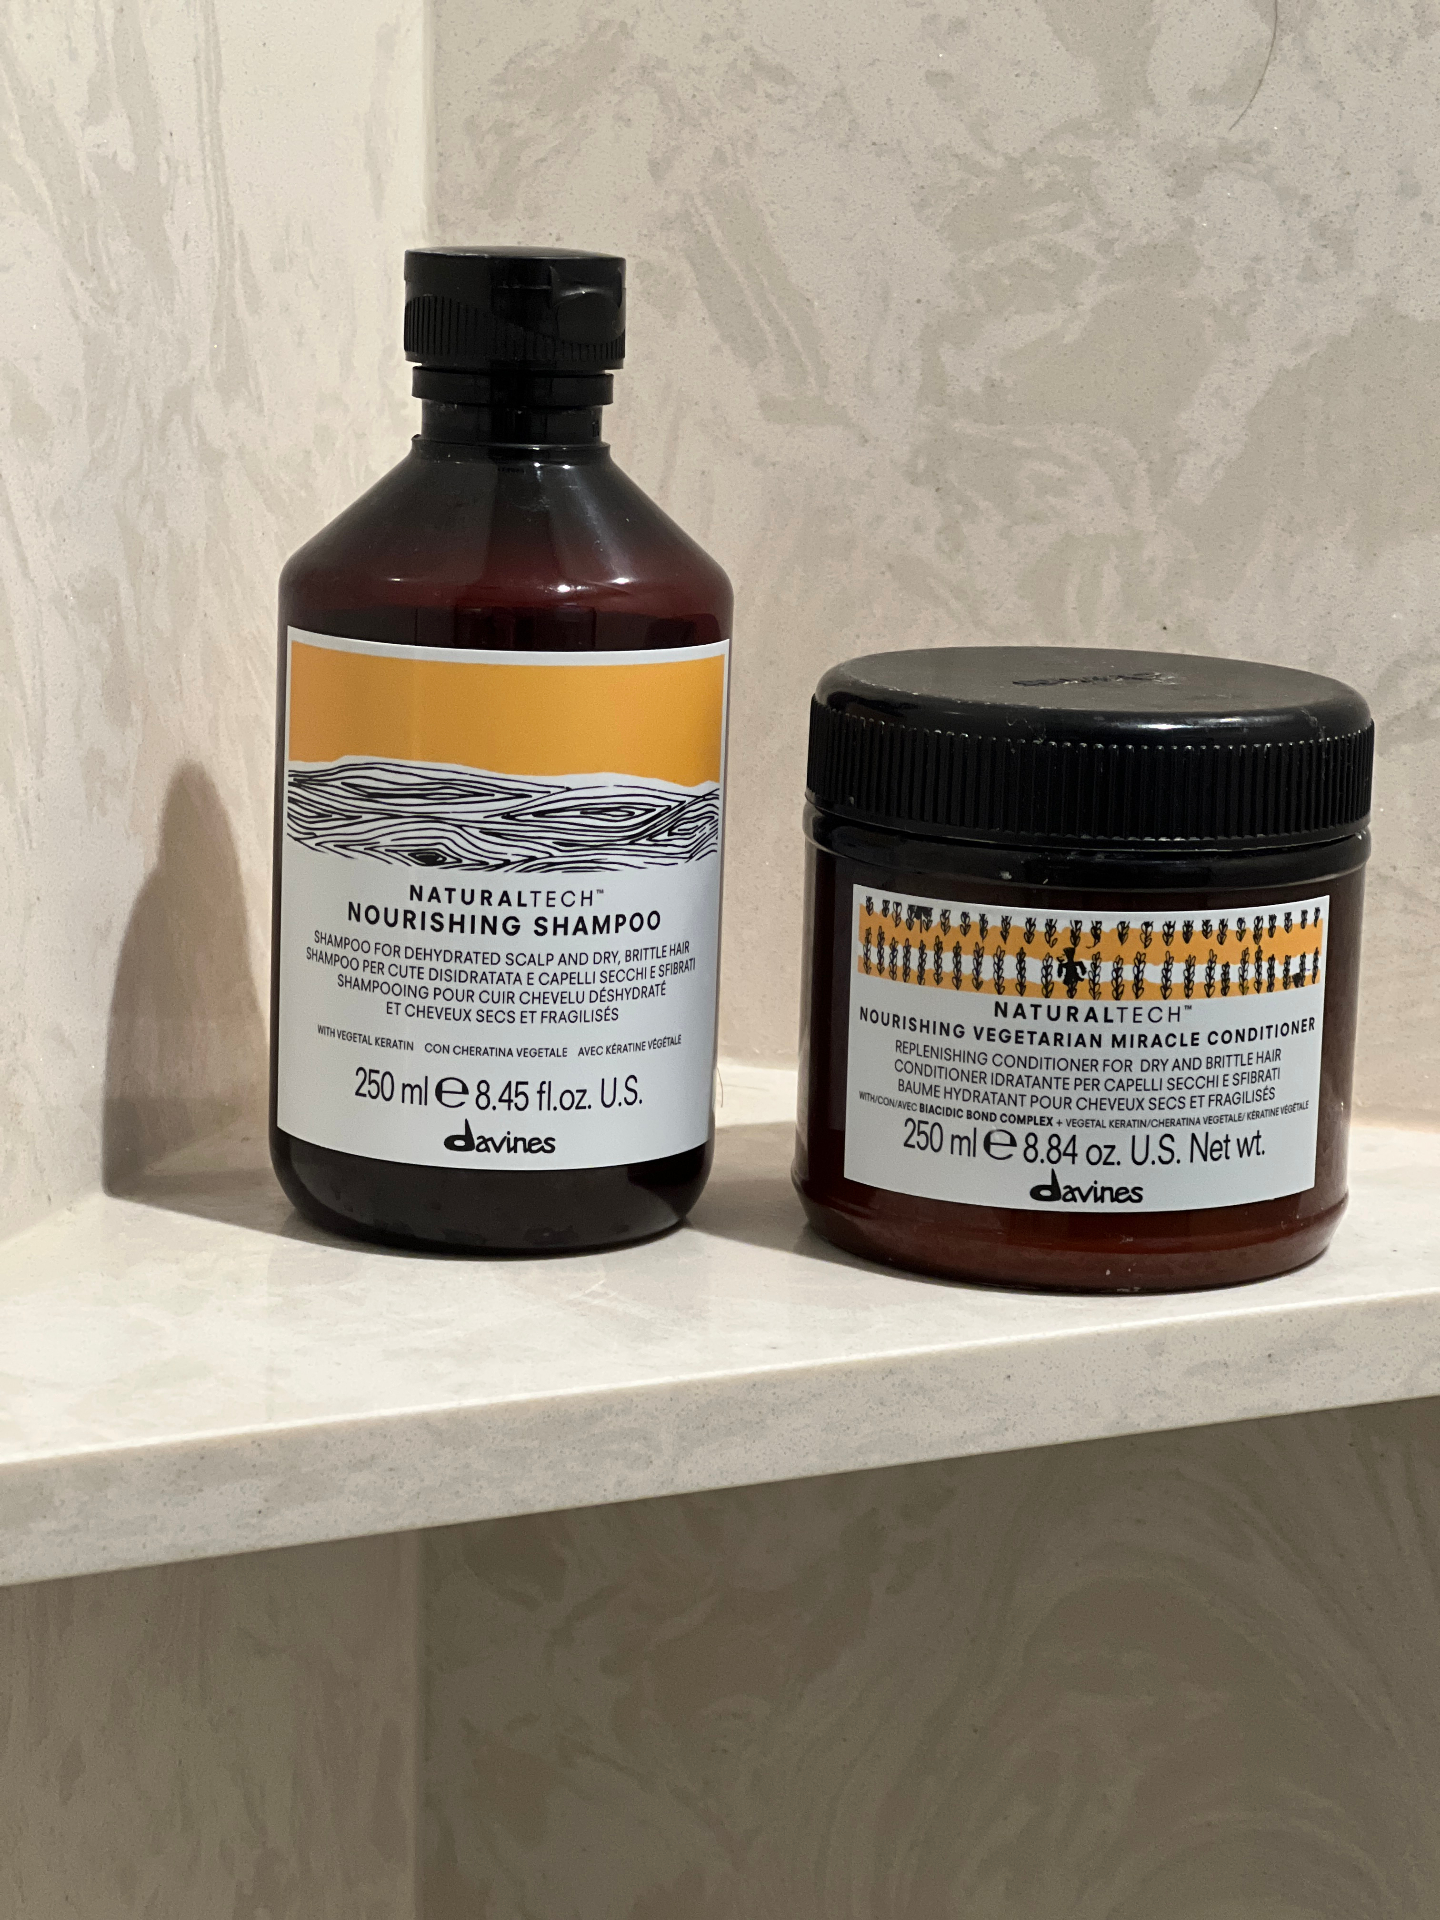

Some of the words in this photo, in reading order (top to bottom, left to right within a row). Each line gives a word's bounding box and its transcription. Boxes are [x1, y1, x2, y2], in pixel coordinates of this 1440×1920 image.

[348, 901, 521, 936] NOURISHING
[534, 910, 660, 936] SHAMPOO
[306, 946, 359, 971] SHAMPOO
[363, 959, 384, 975] PER
[388, 964, 424, 980] CUTE
[429, 968, 522, 985] DISIDRATATA
[527, 972, 534, 986] E
[538, 971, 595, 986] CAPELLI
[600, 966, 647, 984] SECCHI
[650, 966, 656, 979] E
[658, 958, 695, 978] SFIBRATI
[314, 930, 370, 954] SHAMPOO
[374, 942, 400, 958] FOR
[405, 946, 501, 965] DEHYDRATED
[505, 952, 554, 966] SCALP
[558, 952, 588, 966] AND
[593, 950, 620, 966] DRY,
[625, 945, 667, 962] BRITTLE
[670, 940, 689, 956] HAIR
[338, 974, 429, 999] SHAMPOOING
[434, 987, 474, 1003] POUR
[479, 990, 515, 1004] CUIR
[519, 990, 584, 1005] CHEVELU
[589, 980, 666, 1003] DÉSHYDRATÉ
[386, 1001, 402, 1015] ET
[405, 1004, 472, 1022] CHEVEUX
[476, 1009, 515, 1024] SECS
[520, 1010, 537, 1024] ET
[541, 1006, 618, 1024] FRAGILISÉS
[860, 1006, 965, 1038] NOURISHING
[973, 1026, 1102, 1048] VEGETARIAN
[1112, 1032, 1200, 1048] MIRACLE
[1207, 1017, 1315, 1045] CONDITIONER
[318, 1024, 335, 1038] WITH
[337, 1029, 372, 1045] VEGETAL
[375, 1037, 414, 1051] KERATIN
[424, 1043, 450, 1054] CON
[453, 1045, 514, 1057] CHERATINA
[516, 1048, 568, 1058] VEGETALE
[578, 1046, 603, 1056] AVEC
[606, 1041, 646, 1054] KÉRATINE
[648, 1034, 681, 1050] VÉGÉTALE
[896, 1040, 988, 1066] REPLENISHING
[992, 1053, 1099, 1072] CONDITIONER
[1102, 1059, 1133, 1072] FOR
[1140, 1058, 1169, 1072] DRY
[1171, 1057, 1202, 1072] AND
[1206, 1052, 1253, 1070] BRITTLE
[1256, 1048, 1281, 1064] HAIR
[355, 1067, 394, 1102] 250
[402, 1076, 428, 1106] ml
[475, 1080, 529, 1111] 8.45
[536, 1081, 592, 1111] fl.oz.
[601, 1075, 642, 1108] U.S.
[894, 1059, 987, 1085] CONDITIONER
[991, 1072, 1070, 1090] IDRATANTE
[1074, 1078, 1100, 1092] PER
[1104, 1078, 1162, 1092] CAPELLI
[1166, 1075, 1219, 1091] SECCHI
[1222, 1074, 1230, 1087] E
[1232, 1067, 1280, 1086] SFIBRATI
[859, 1091, 917, 1112] WITH/CON/AVEC
[919, 1103, 964, 1118] BIACIDIC
[966, 1110, 997, 1122] BOND
[1000, 1113, 1053, 1127] COMPLEX
[1056, 1119, 1063, 1127] +
[1066, 1118, 1106, 1128] VEGETAL
[1109, 1117, 1201, 1128] KERATIN/CHERATINA
[1203, 1112, 1246, 1124] VEGETALE/
[1247, 1107, 1279, 1120] KÉRATINE
[1280, 1100, 1309, 1114] VÉGÉTALE
[898, 1078, 940, 1098] BAUME
[944, 1086, 1027, 1107] HYDRATANT
[1030, 1094, 1072, 1110] POUR
[1076, 1097, 1145, 1111] CHEVEUX
[1148, 1096, 1186, 1110] SECS
[1190, 1095, 1205, 1109] ET
[1208, 1085, 1275, 1108] FRAGILISÉS
[444, 1118, 556, 1154] davines
[904, 1118, 943, 1153] 250
[950, 1127, 977, 1158] ml
[1023, 1132, 1078, 1165] 8.84
[1086, 1144, 1121, 1166] oz.
[1131, 1133, 1180, 1166] U.S.
[1190, 1132, 1231, 1163] Net
[1236, 1130, 1265, 1158] wt.
[1029, 1168, 1144, 1204] davines
